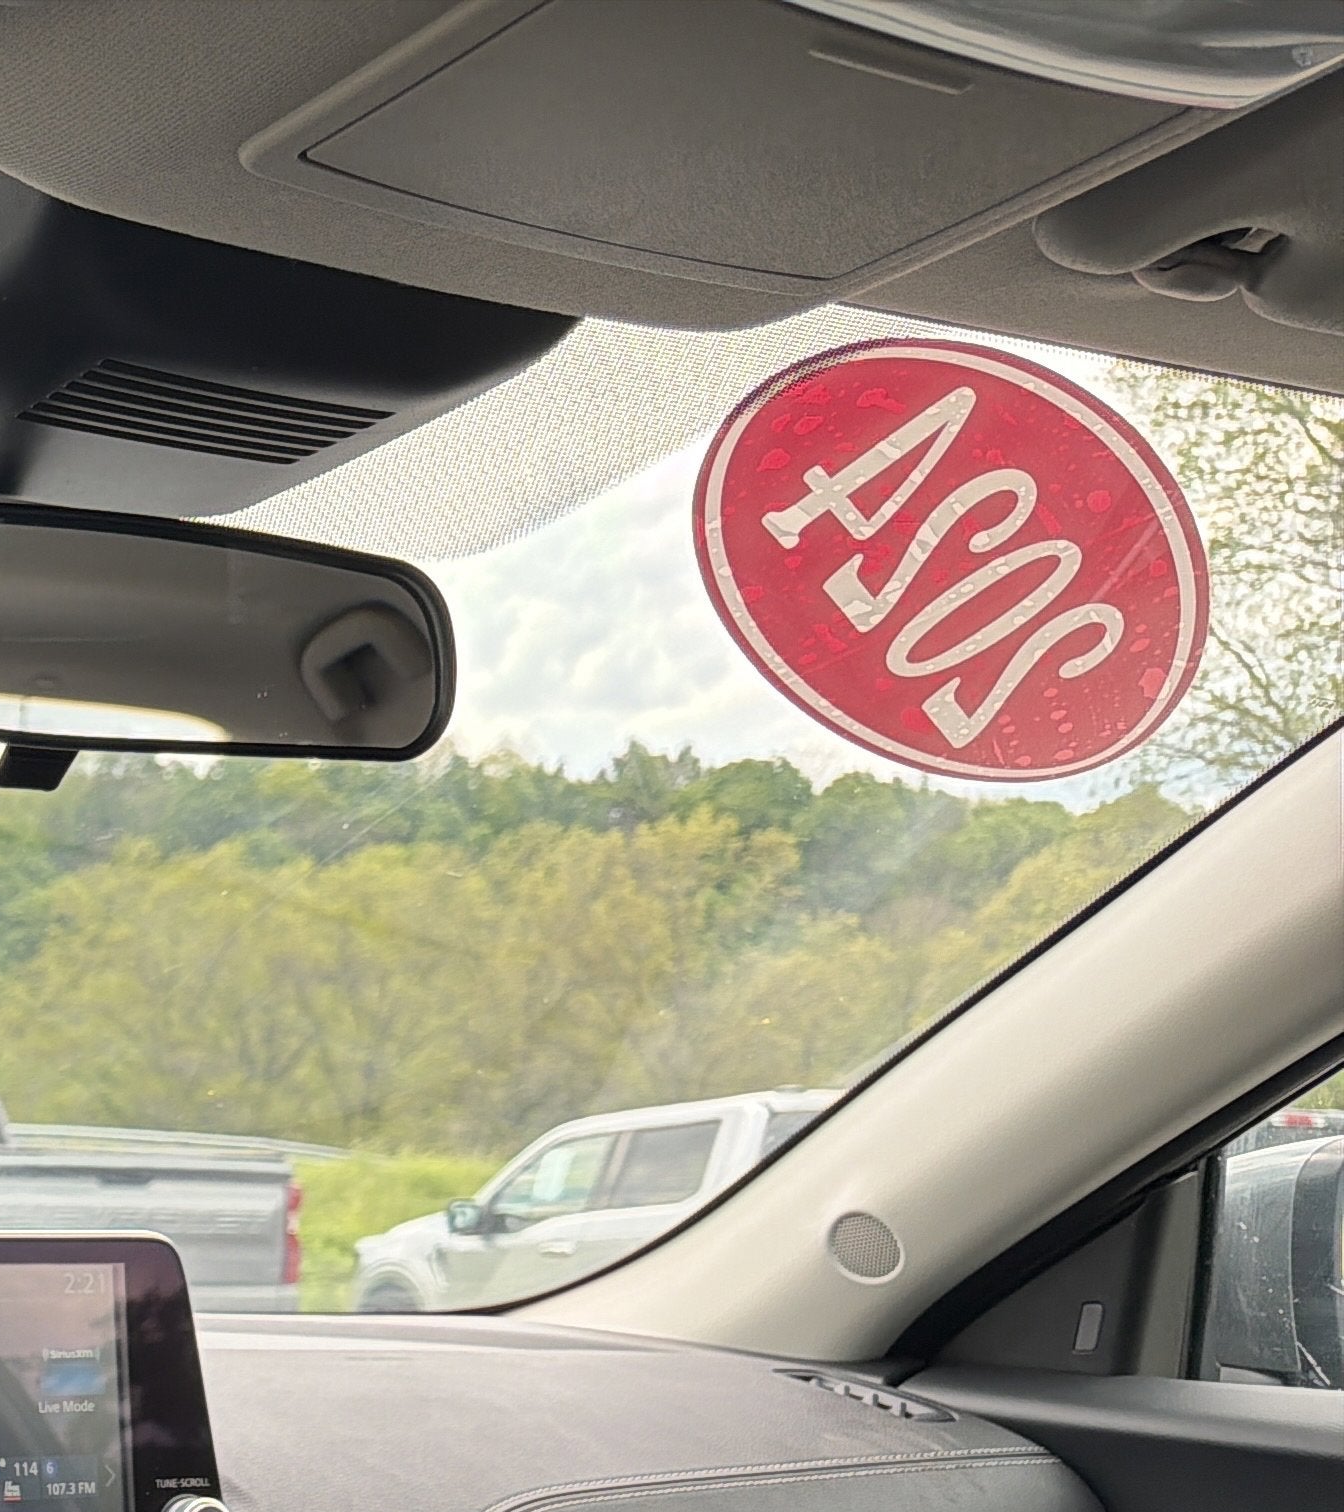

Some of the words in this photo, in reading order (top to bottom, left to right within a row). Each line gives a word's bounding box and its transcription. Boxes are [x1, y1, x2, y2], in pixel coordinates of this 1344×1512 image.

[64, 1272, 106, 1294] 2:21
[38, 1401, 61, 1414] Live
[62, 1400, 96, 1413] Mode
[13, 1461, 39, 1477] 114
[45, 1461, 54, 1474] 6
[46, 1482, 76, 1496] 107.3
[77, 1481, 97, 1495] FM
